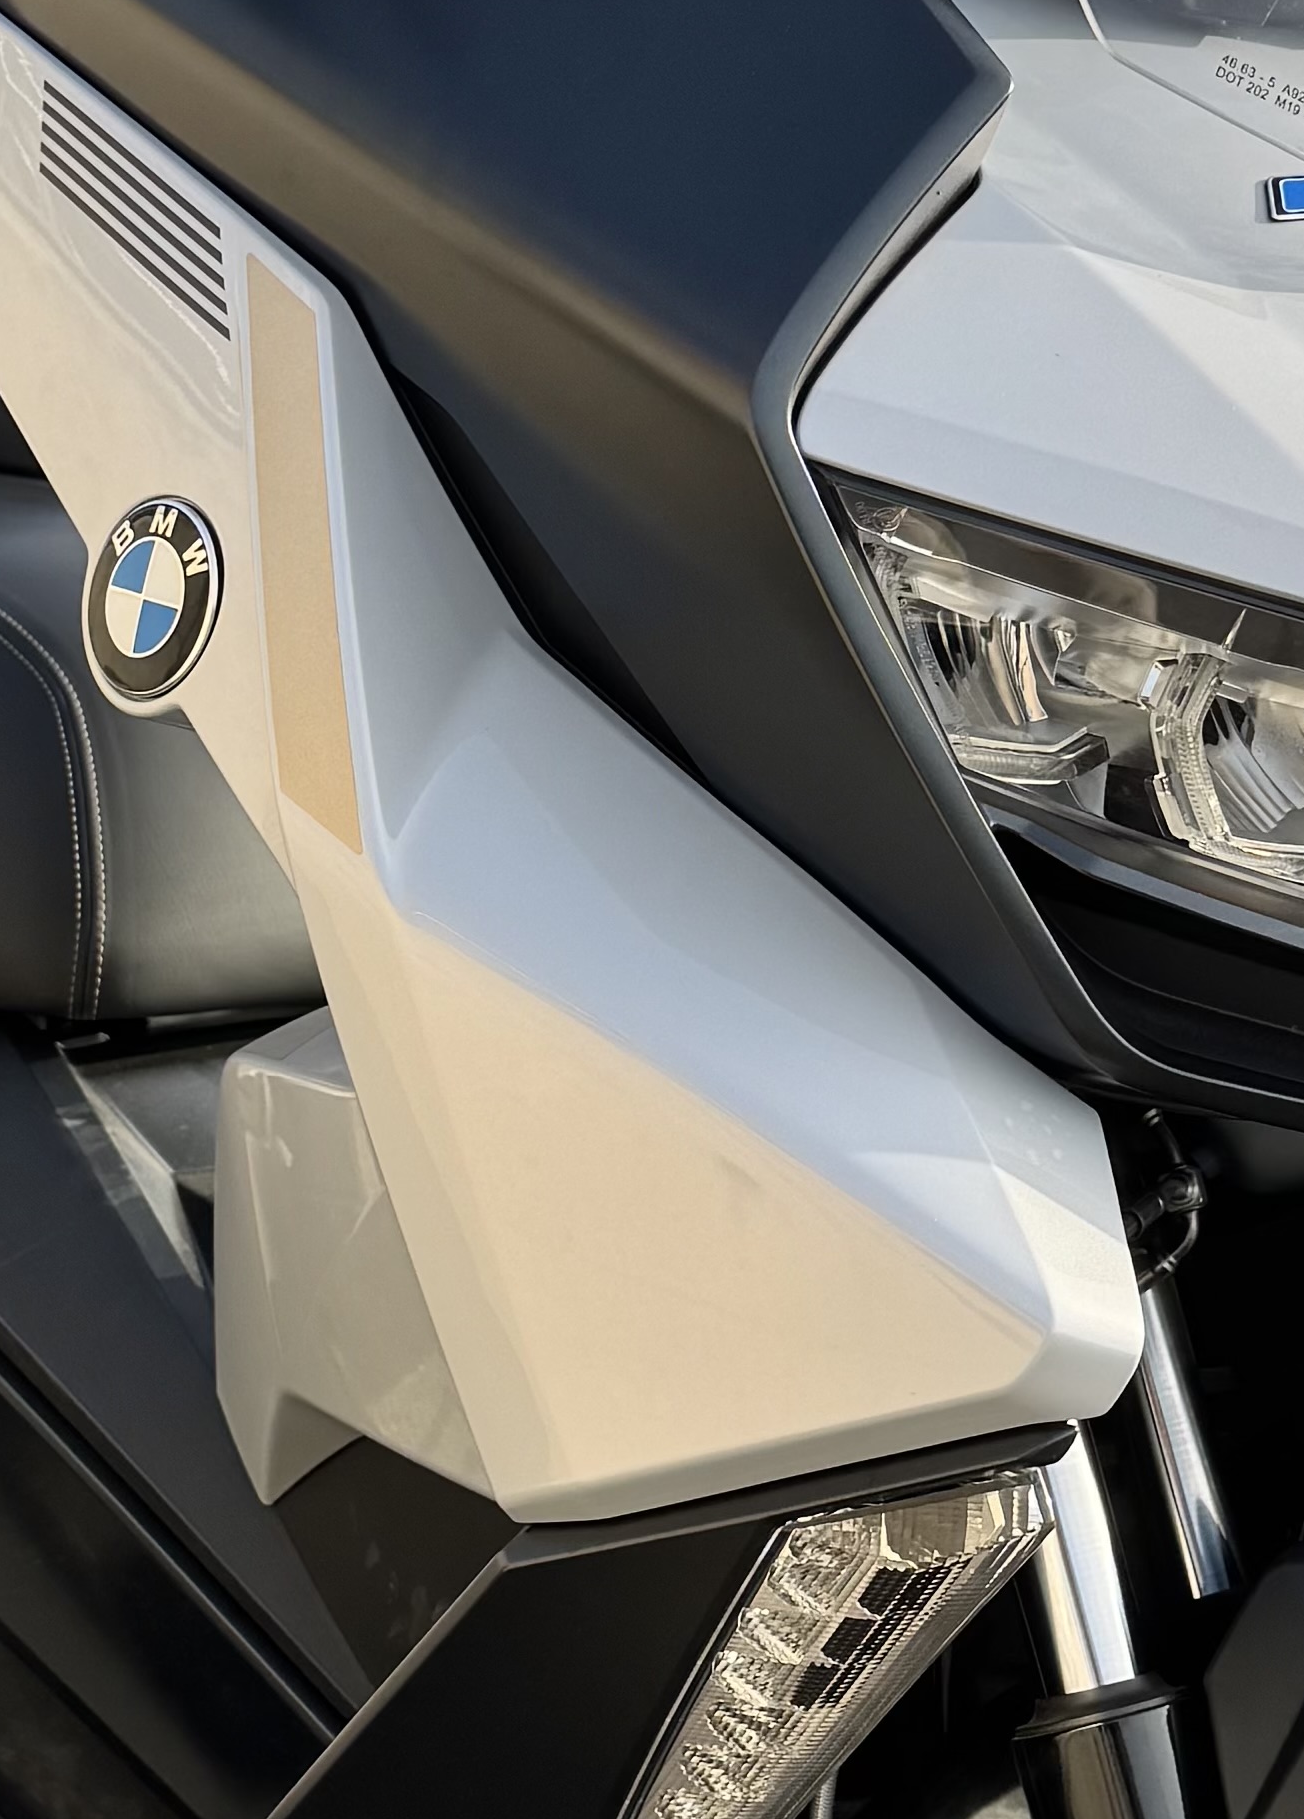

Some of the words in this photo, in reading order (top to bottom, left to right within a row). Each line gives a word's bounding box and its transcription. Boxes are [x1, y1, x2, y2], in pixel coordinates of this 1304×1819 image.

[1215, 65, 1245, 87] DOT
[1245, 81, 1270, 100] 202
[1267, 76, 1277, 88] 5
[111, 505, 209, 577] BMW
